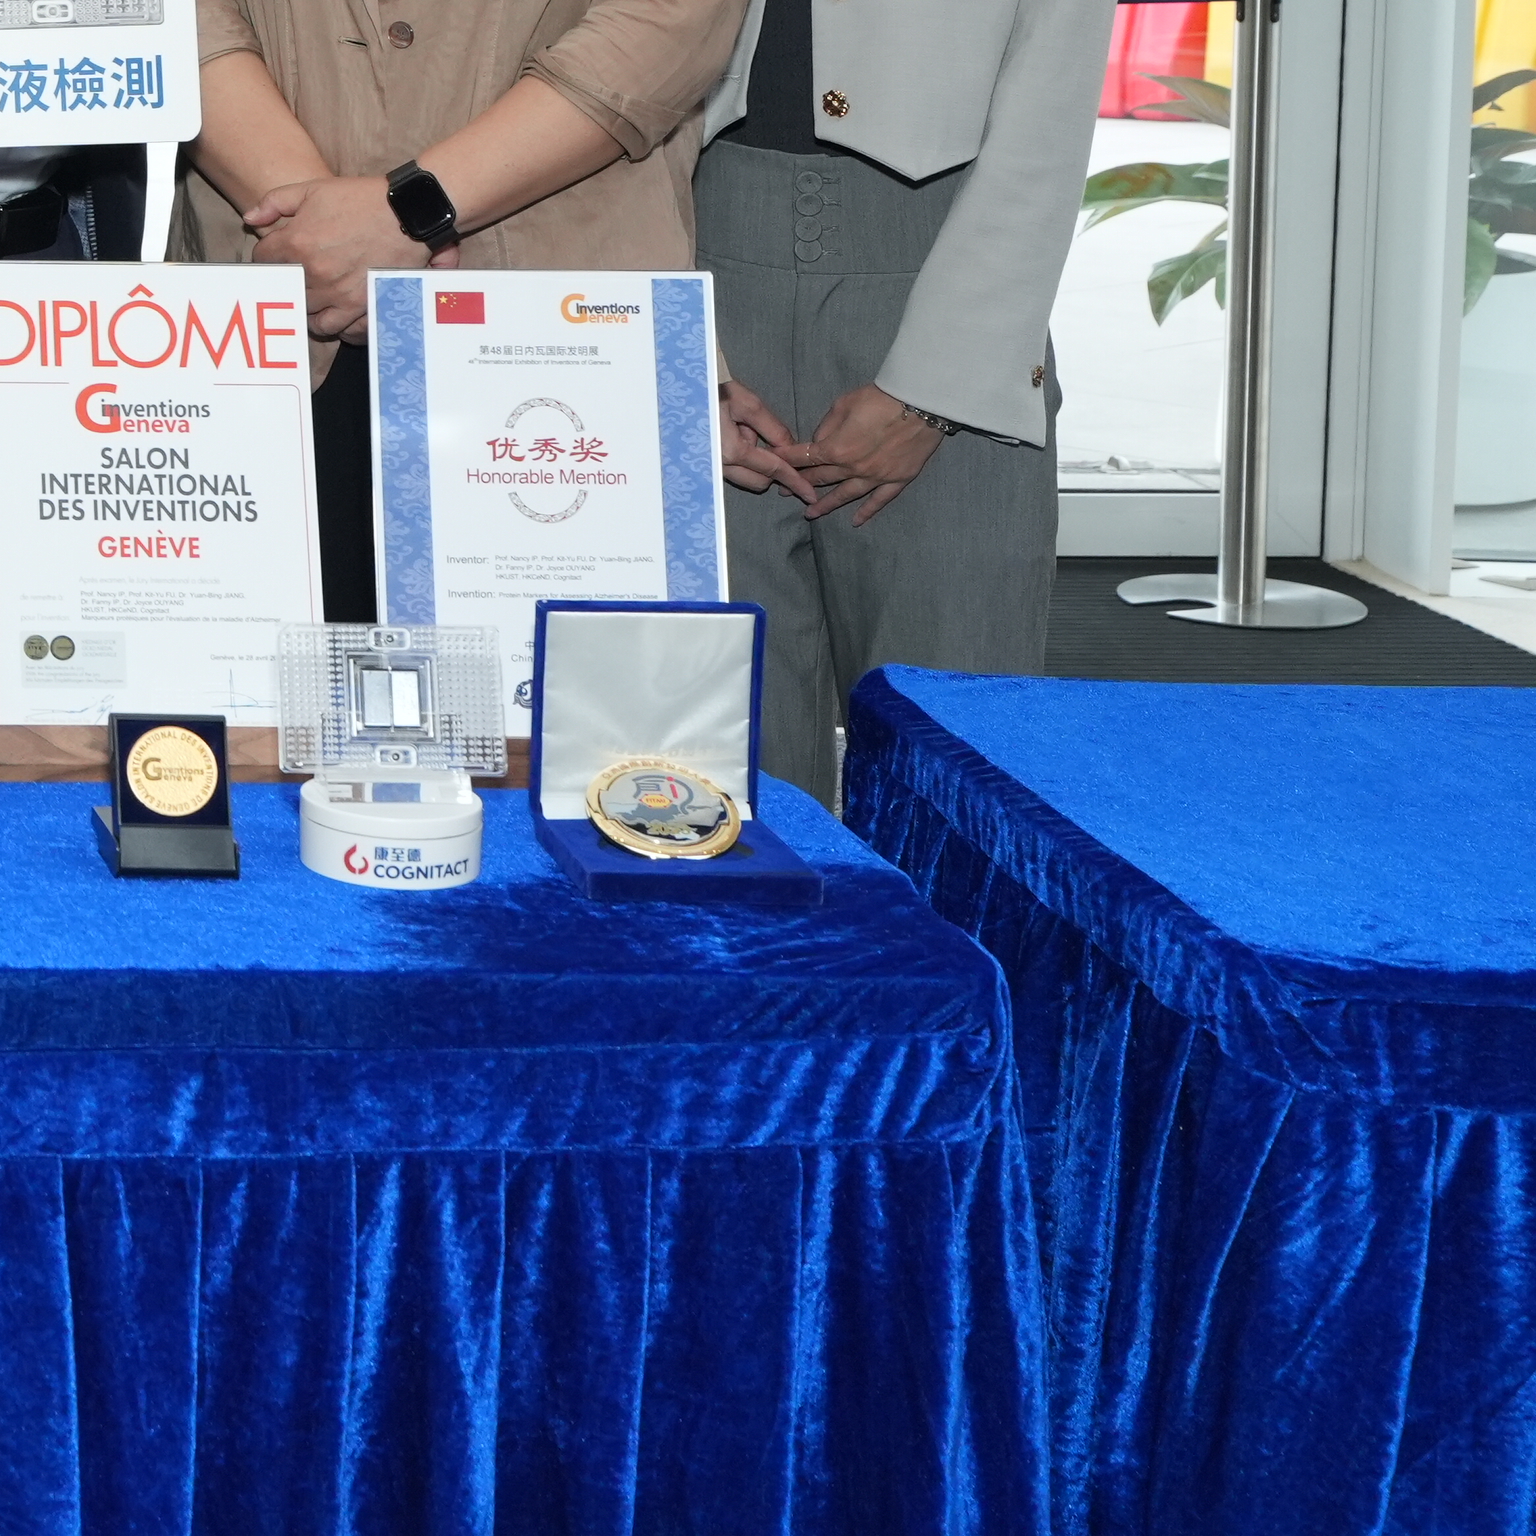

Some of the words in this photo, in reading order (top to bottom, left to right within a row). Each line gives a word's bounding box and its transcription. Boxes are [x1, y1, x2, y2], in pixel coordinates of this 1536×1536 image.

[560, 293, 629, 324] Geneva
[75, 382, 191, 434] Geneva
[100, 447, 190, 470] SALON
[486, 436, 610, 464] 优秀奖
[40, 472, 252, 497] INTERNATIONAL
[466, 468, 555, 486] Honorable
[559, 468, 627, 486] Mention
[38, 498, 86, 522] DES
[93, 499, 259, 523] INVENTIONS
[97, 529, 201, 559] GENÈVE
[446, 555, 490, 565] Inventor:
[447, 589, 496, 599] Invention:
[510, 653, 533, 663] Chin
[373, 847, 423, 864] 康至德
[373, 860, 469, 882] COGNITACT
